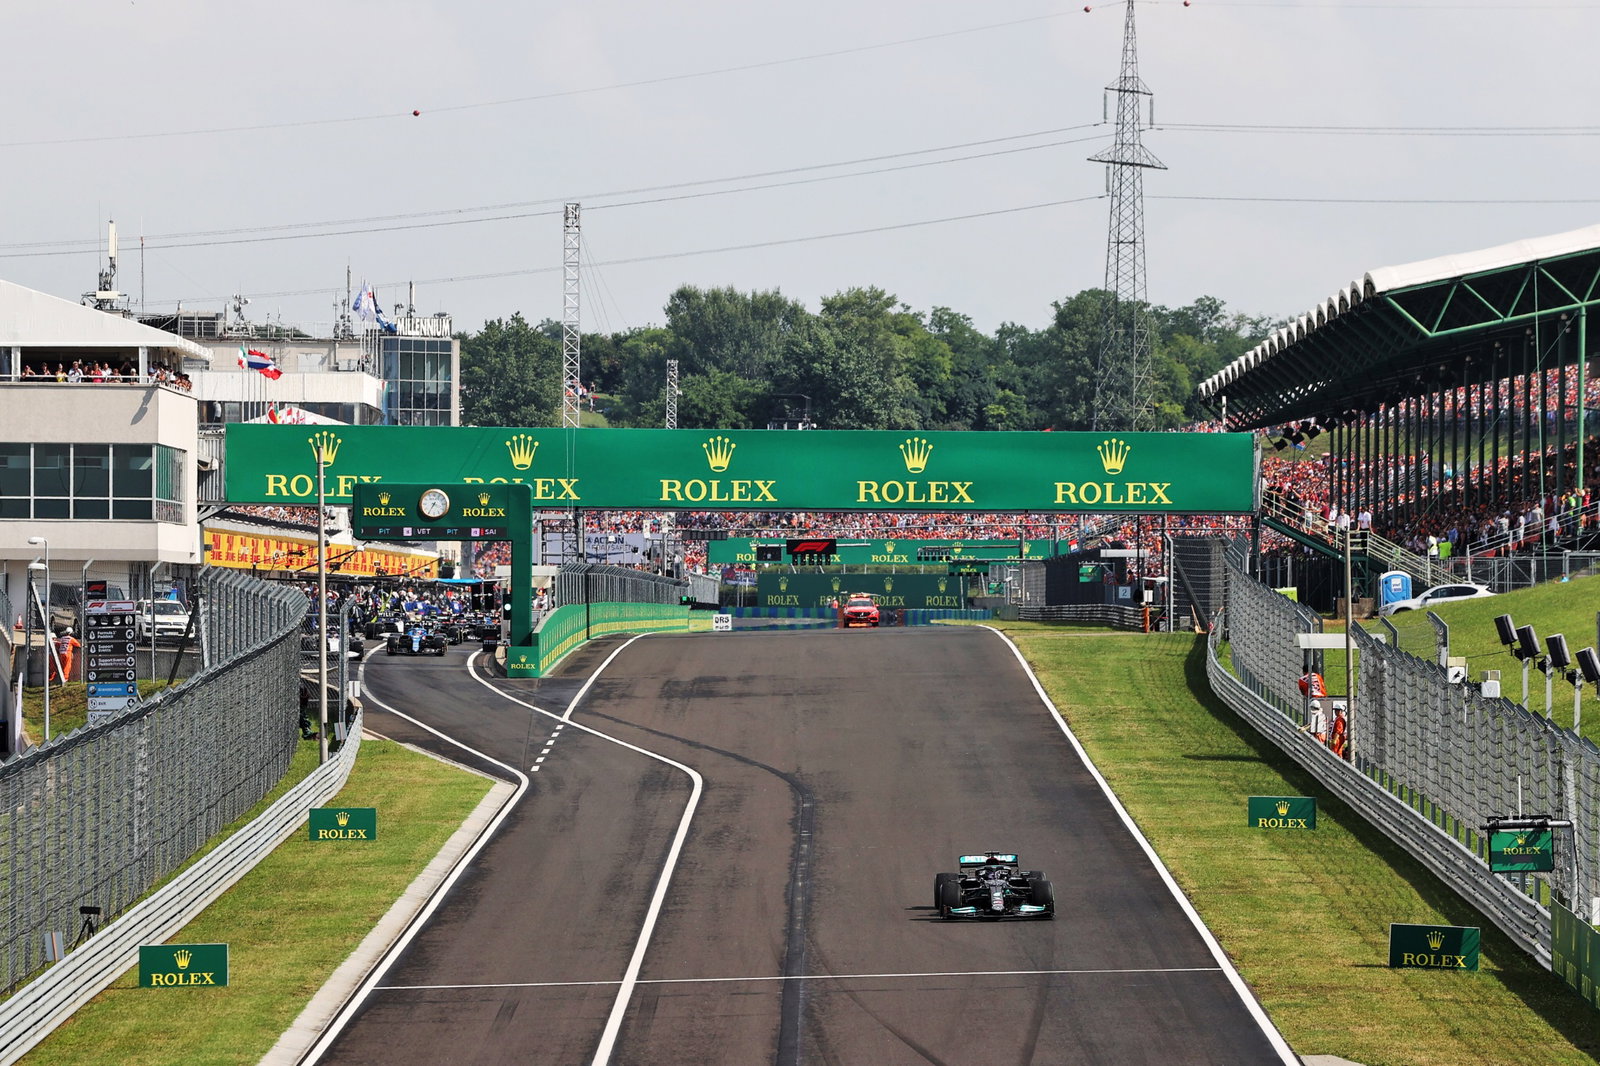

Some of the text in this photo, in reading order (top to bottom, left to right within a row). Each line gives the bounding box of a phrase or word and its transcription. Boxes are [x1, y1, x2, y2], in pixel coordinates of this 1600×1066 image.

[397, 317, 451, 336] MILLENNIUM
[660, 479, 778, 502] ROLEX
[857, 481, 975, 503] ROLEX
[1054, 482, 1173, 504] ROLEX
[363, 508, 406, 516] ROLEX
[463, 508, 506, 517] ROLEX
[871, 554, 909, 563] ROLEX
[1121, 588, 1129, 597] 2
[767, 594, 800, 606] ROLEX
[925, 595, 958, 607] ROLEX
[714, 616, 730, 624] DRS
[1258, 817, 1308, 829] ROLEX
[318, 829, 367, 839] ROLEX
[1502, 846, 1541, 855] ROLEX
[1402, 952, 1467, 968] ROLEX
[151, 972, 215, 986] ROLEX
